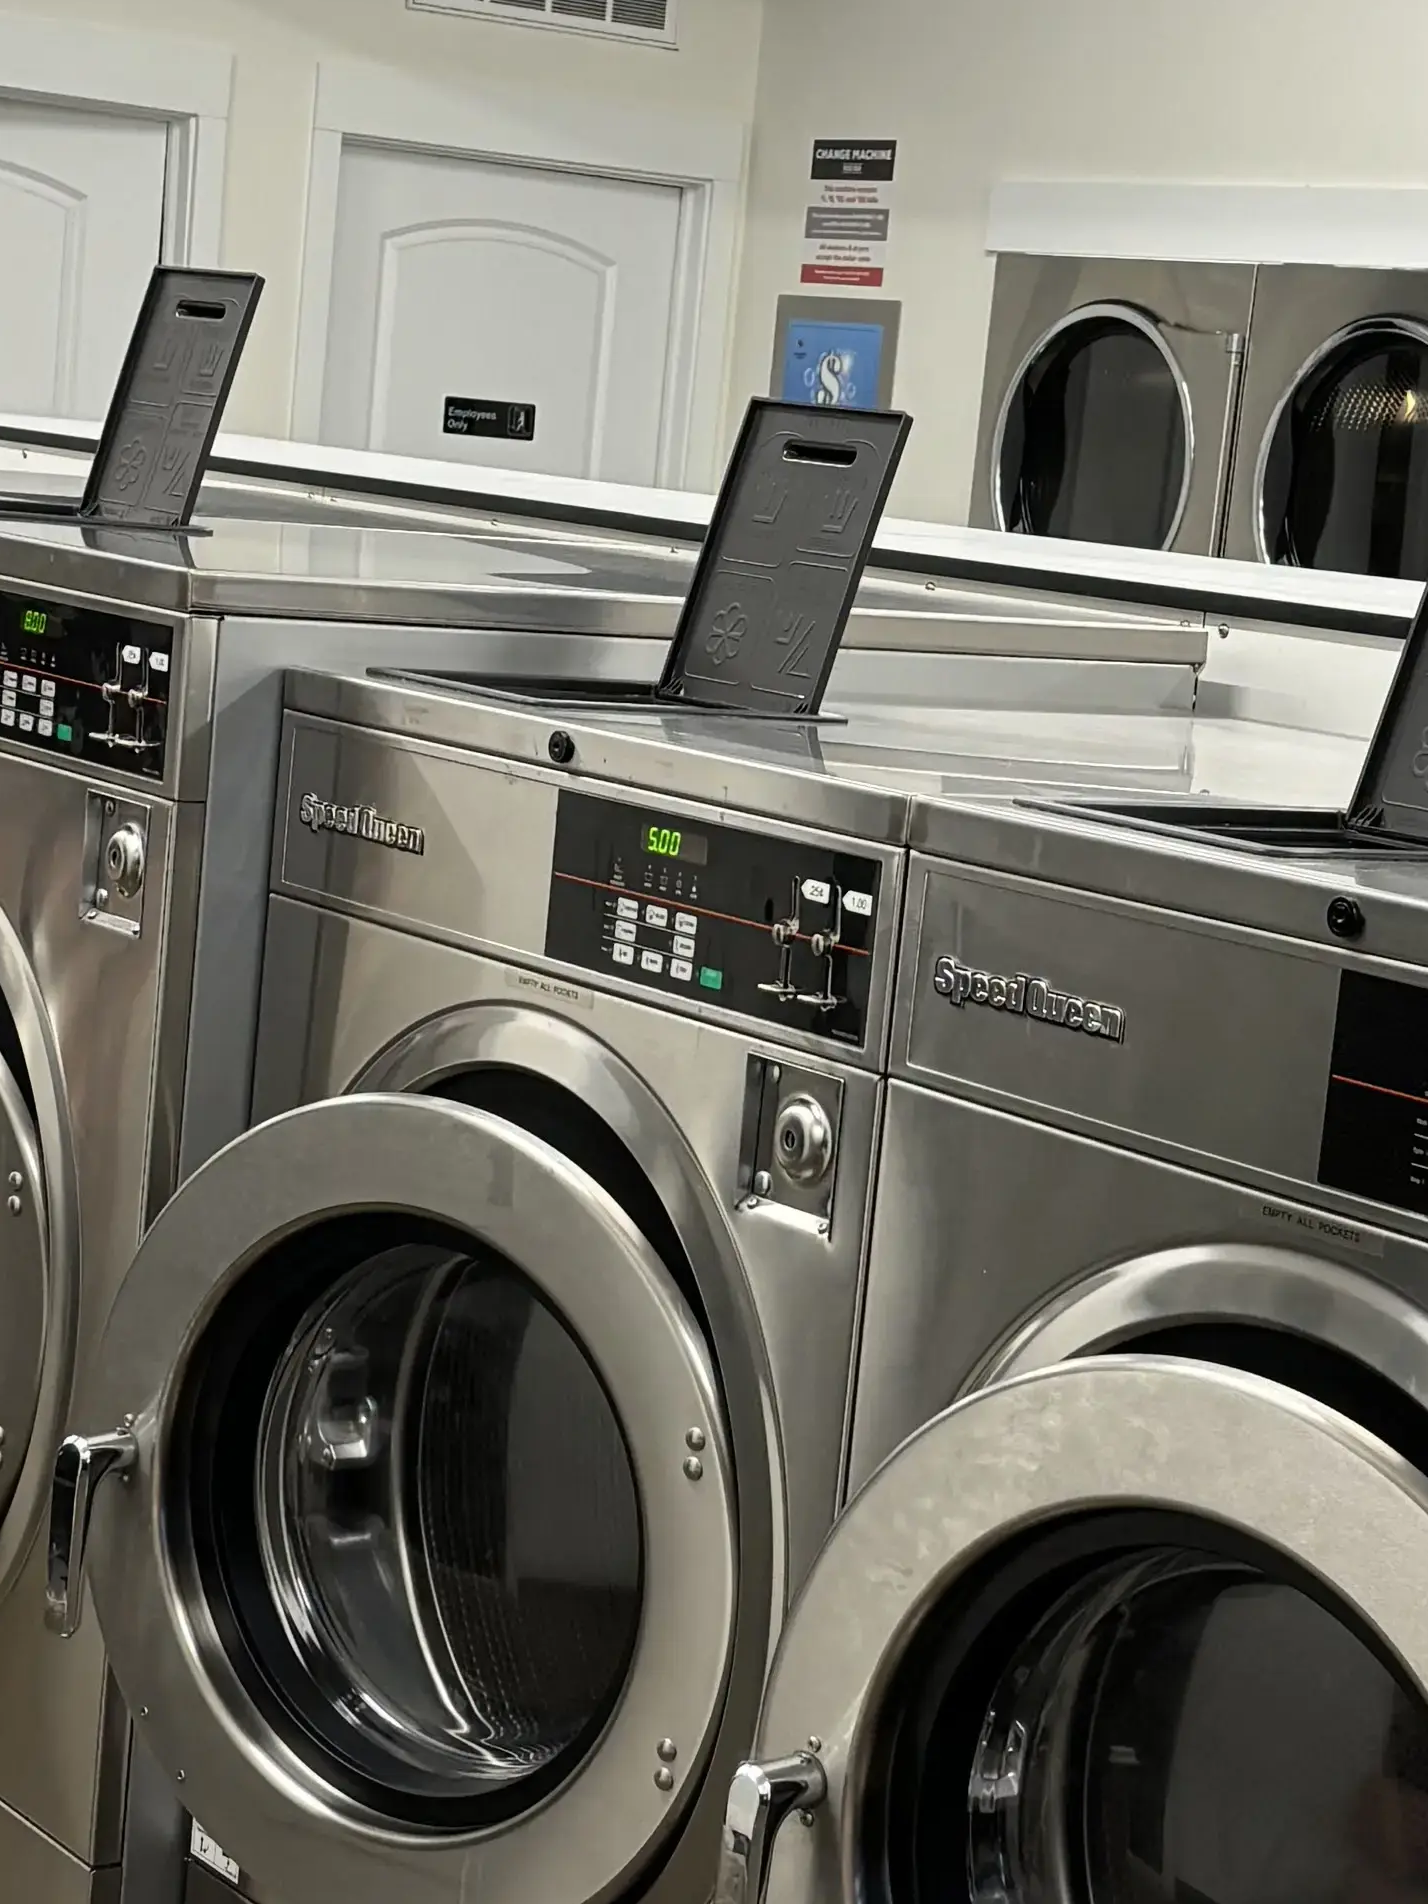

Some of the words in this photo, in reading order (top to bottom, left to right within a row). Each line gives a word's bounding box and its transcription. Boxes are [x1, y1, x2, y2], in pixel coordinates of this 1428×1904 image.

[647, 826, 682, 857] 5.00
[934, 955, 1026, 1013] Speed
[1026, 977, 1125, 1042] Queen
[1297, 1217, 1314, 1229] ALL
